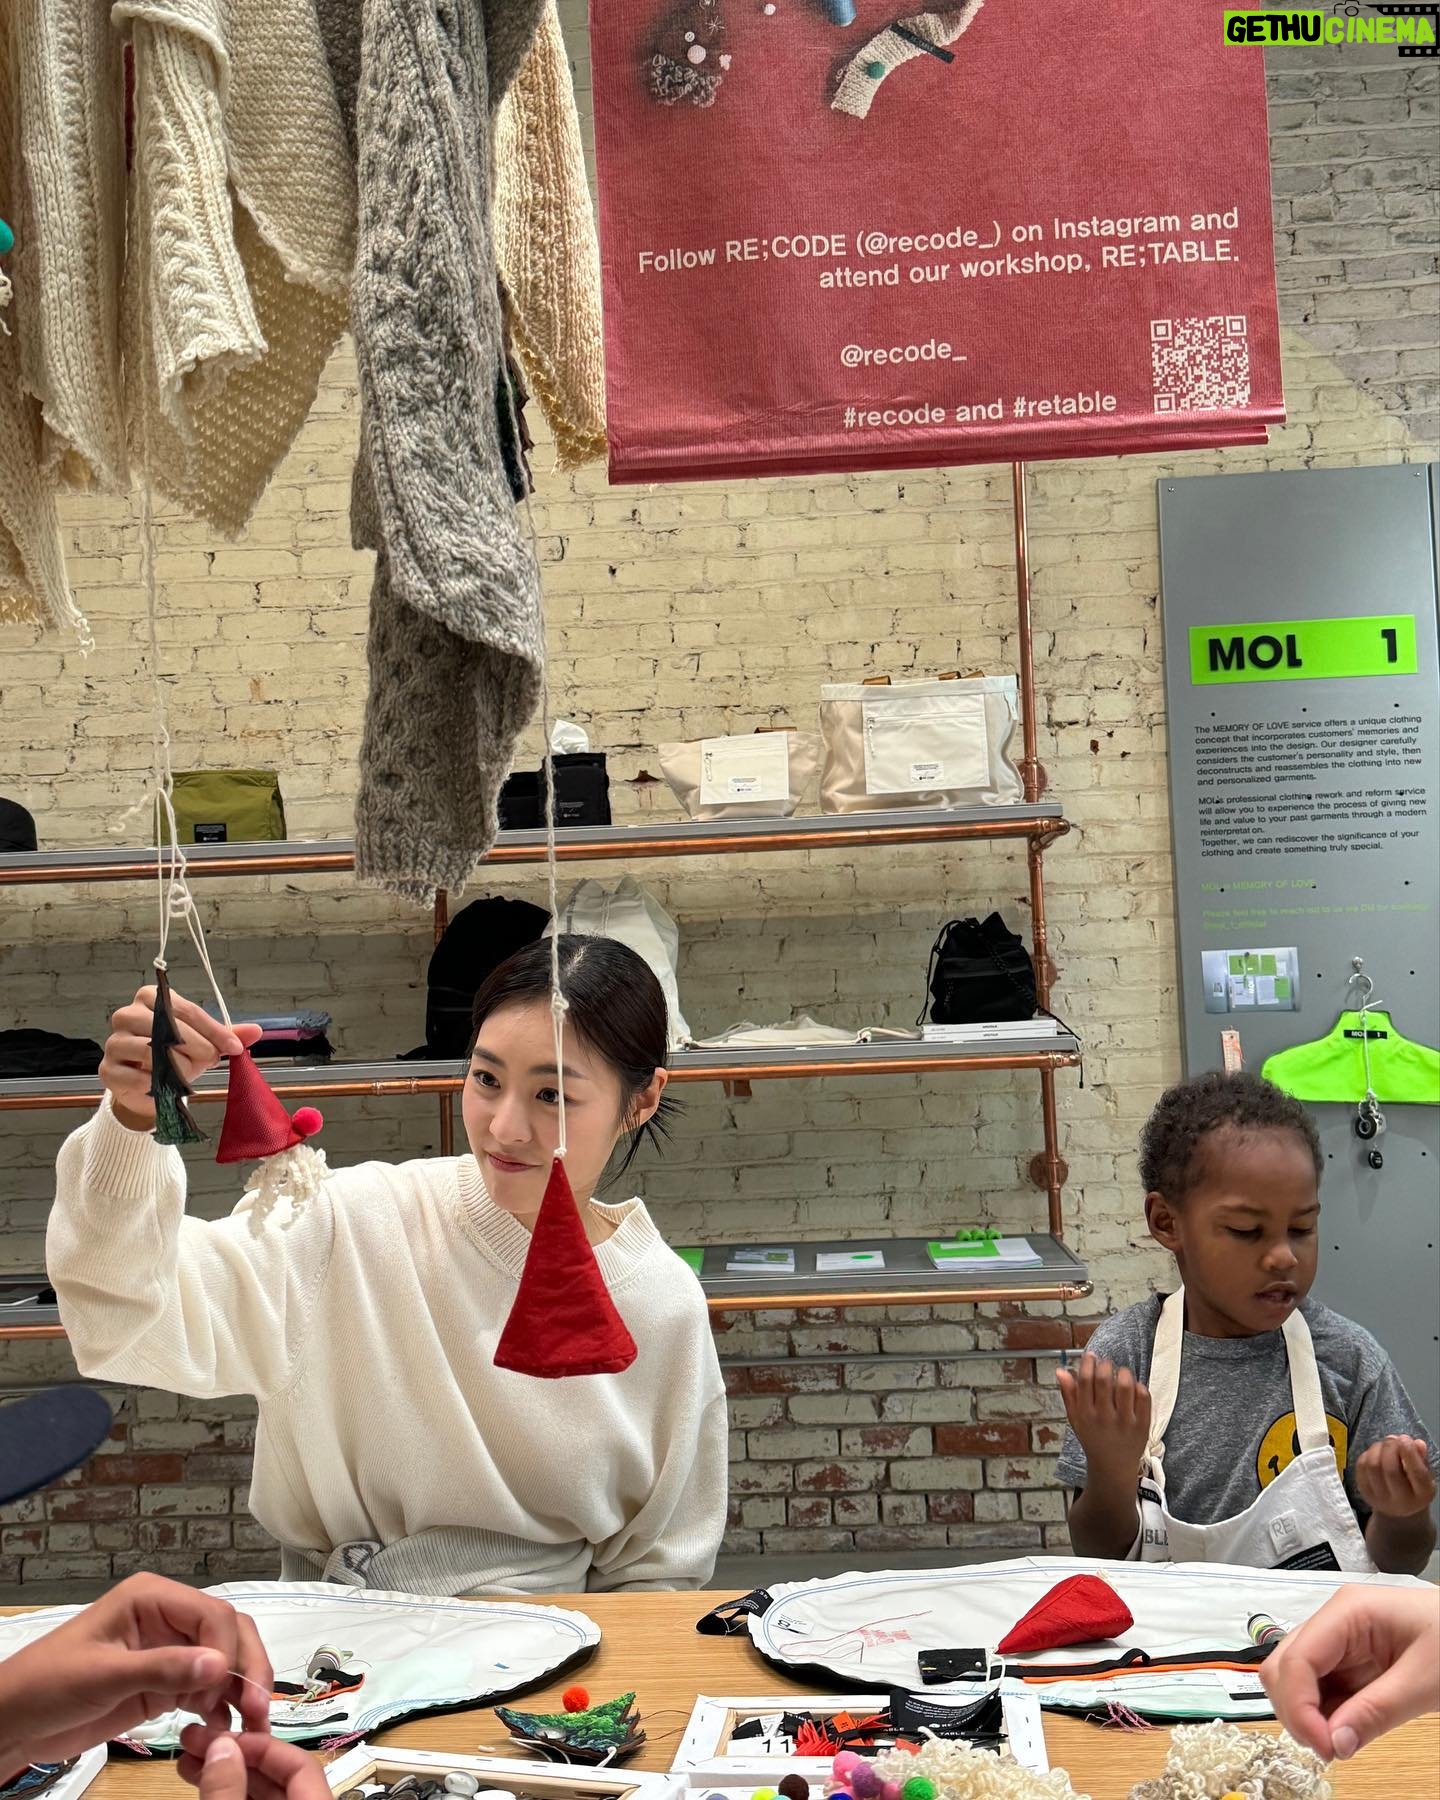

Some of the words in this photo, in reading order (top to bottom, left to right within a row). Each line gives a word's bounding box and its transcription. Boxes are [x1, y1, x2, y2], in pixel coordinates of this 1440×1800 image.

[639, 249, 715, 273] Follow
[727, 234, 846, 262] RE;CODE
[857, 221, 1000, 249] (@recode_)
[1012, 225, 1042, 242] on
[1055, 216, 1180, 239] Instagram
[1191, 207, 1238, 230] and
[820, 264, 899, 288] attend
[910, 264, 950, 283] our
[958, 250, 1090, 277] workshop,
[1103, 236, 1238, 267] RE;TABLE.
[841, 339, 967, 367] @recode_
[844, 403, 945, 430] #recode
[956, 399, 1003, 421] and
[1013, 391, 1116, 421] #retable
[1208, 634, 1302, 672] MOL
[1381, 628, 1398, 663] 1
[1213, 723, 1249, 732] MEMORY
[1252, 722, 1264, 730] OF
[1266, 721, 1289, 730] LOVE
[1389, 715, 1421, 724] clothing
[1195, 736, 1230, 744] concept
[1252, 732, 1306, 741] incorporates
[1308, 727, 1354, 738] customers'
[1357, 727, 1399, 735] memories
[1402, 725, 1418, 733] and
[1195, 746, 1248, 754] experiences
[1339, 739, 1377, 747] designer
[1380, 736, 1416, 745] carefully
[1196, 756, 1237, 765] considers
[1256, 751, 1303, 762] customer's
[1306, 750, 1353, 760] personality
[1356, 748, 1373, 756] and
[1376, 747, 1399, 756] style,
[1197, 766, 1252, 775] deconstructs
[1255, 764, 1271, 772] and
[1274, 762, 1328, 771] reassembles
[1348, 759, 1382, 767] clothing
[1197, 778, 1213, 786] and
[1216, 774, 1271, 785] personalized
[1274, 773, 1316, 783] garments.
[1226, 794, 1276, 804] professional
[1315, 791, 1343, 799] rework
[1365, 788, 1392, 796] reform
[1267, 804, 1314, 812] experience
[1333, 801, 1367, 810] process
[1370, 799, 1377, 807] of
[1380, 799, 1406, 808] giving
[1214, 816, 1230, 825] and
[1290, 814, 1307, 822] past
[1310, 811, 1349, 821] garments
[1351, 809, 1383, 818] through
[1394, 808, 1426, 816] modern
[1200, 838, 1239, 847] Together,
[1275, 835, 1318, 843] rediscover
[1337, 832, 1386, 841] significance
[1284, 845, 1326, 853] something
[1329, 843, 1347, 852] truly
[1350, 841, 1382, 850] special.
